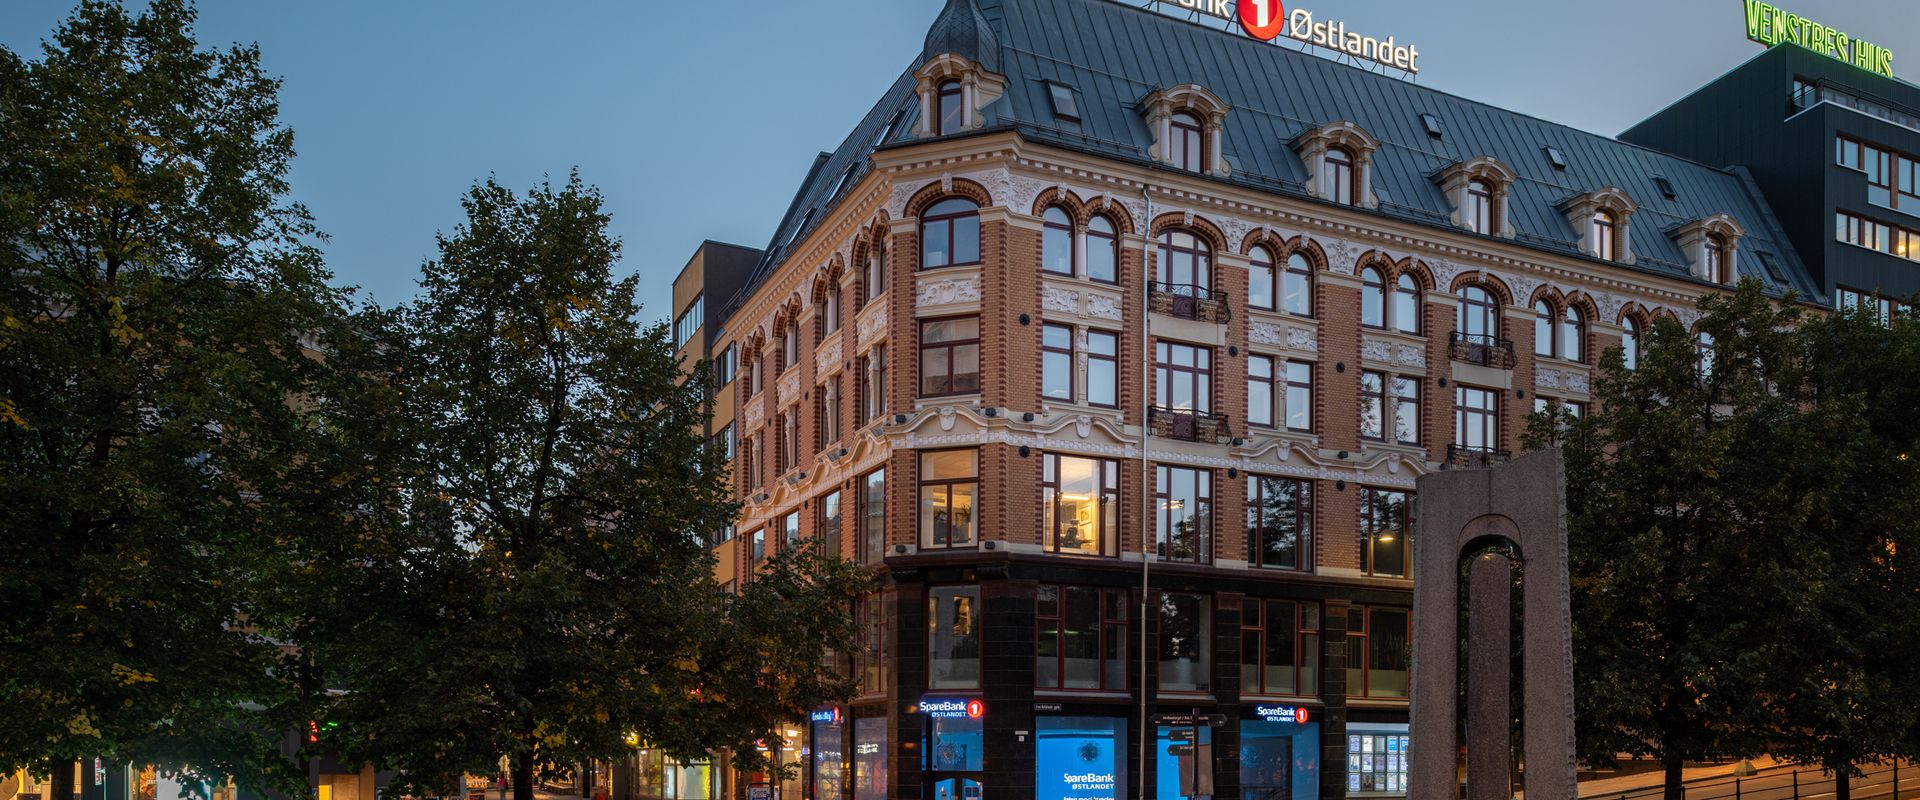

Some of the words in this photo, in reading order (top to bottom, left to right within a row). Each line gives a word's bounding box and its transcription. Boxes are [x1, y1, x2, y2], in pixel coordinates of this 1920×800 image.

[1289, 8, 1419, 73] Østlandet
[1745, 0, 1849, 63] VENSTRES
[1854, 38, 1894, 79] HUS
[920, 701, 966, 712] SpareBank
[1257, 706, 1295, 716] SpareBank
[1063, 772, 1114, 784] SpareBank
